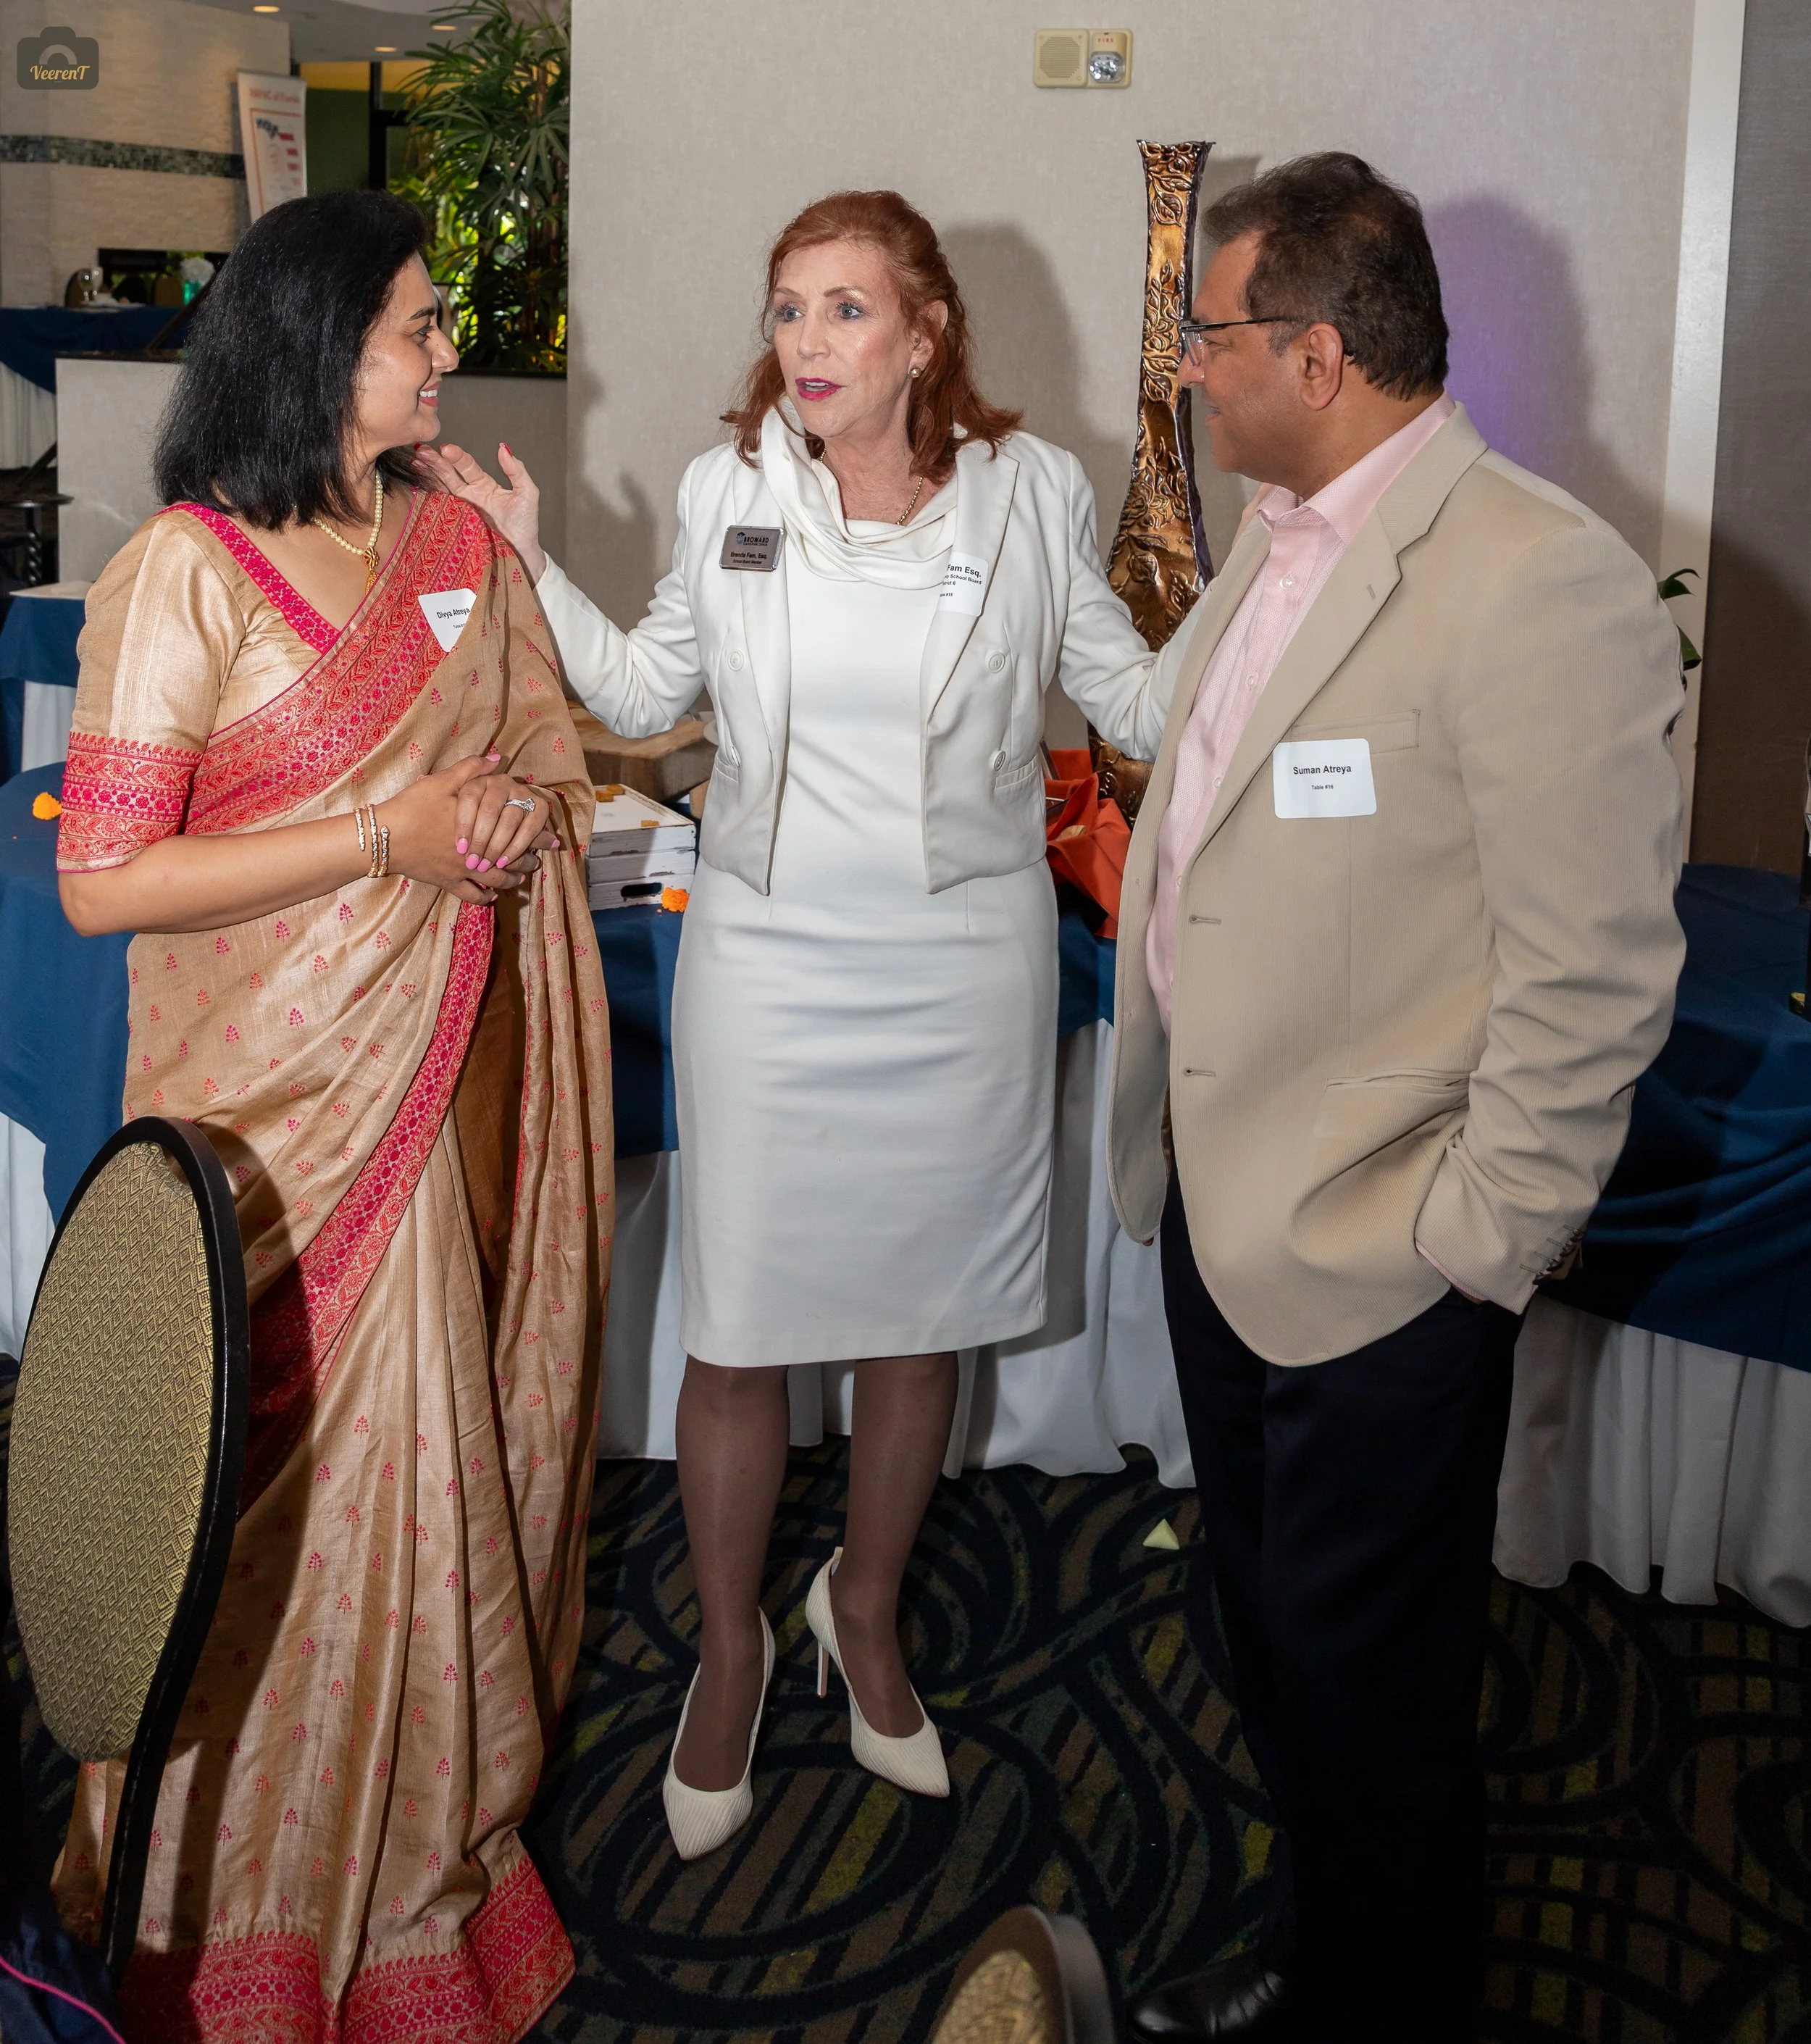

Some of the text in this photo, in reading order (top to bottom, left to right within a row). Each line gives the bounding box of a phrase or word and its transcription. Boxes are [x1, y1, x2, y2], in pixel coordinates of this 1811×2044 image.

[947, 564, 981, 577] Fam Esq.
[436, 611, 453, 620] Divya
[1293, 765, 1352, 775] Suman Atreya
